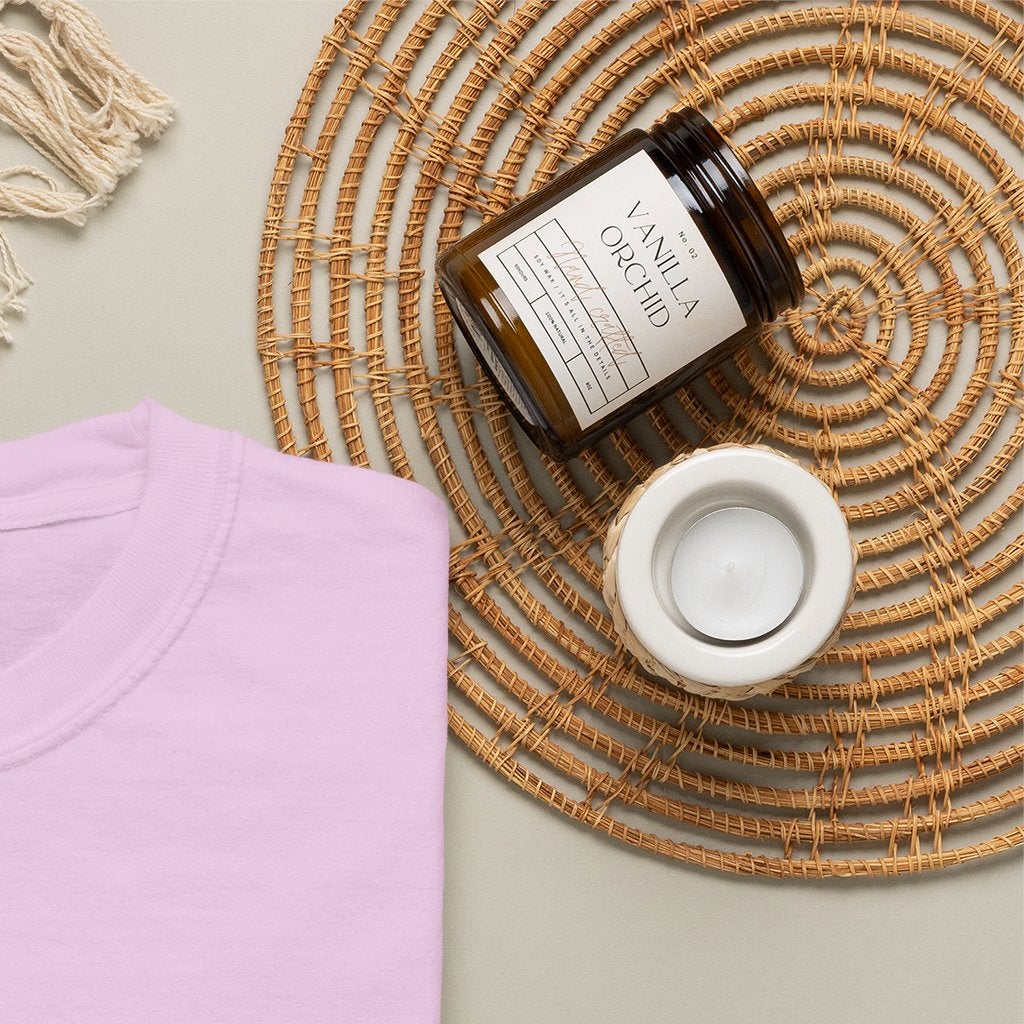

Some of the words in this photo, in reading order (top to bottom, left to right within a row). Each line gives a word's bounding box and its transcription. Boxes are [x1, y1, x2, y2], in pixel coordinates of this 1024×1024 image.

[546, 240, 607, 302] Hand
[590, 307, 643, 367] crafted
[600, 225, 670, 328] ORCHID
[627, 200, 700, 318] VANILLA
[688, 247, 698, 259] 02
[534, 254, 544, 267] SOY
[544, 269, 555, 283] WAX
[558, 291, 569, 306] IT'S
[569, 309, 579, 323] ALL
[578, 324, 586, 333] IN
[585, 335, 596, 349] THE
[593, 352, 611, 380] DETAILS
[553, 323, 566, 345] NATURAL
